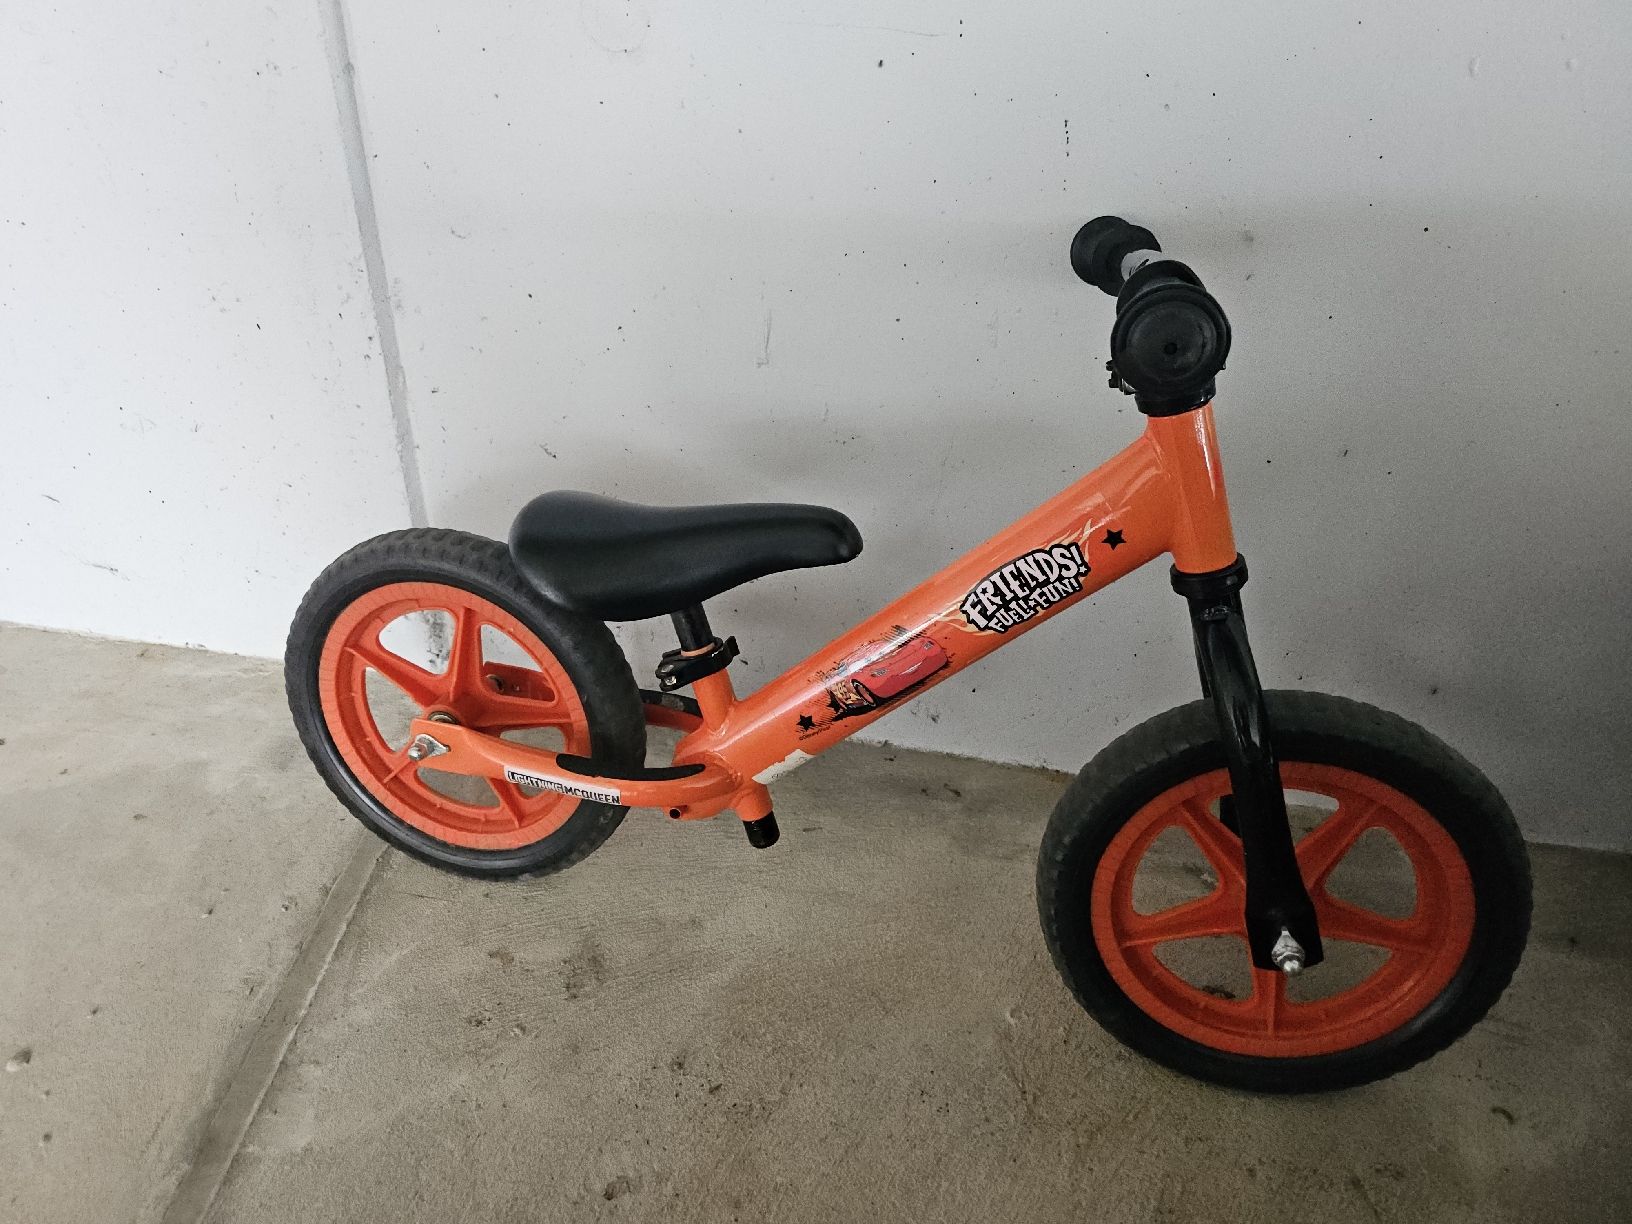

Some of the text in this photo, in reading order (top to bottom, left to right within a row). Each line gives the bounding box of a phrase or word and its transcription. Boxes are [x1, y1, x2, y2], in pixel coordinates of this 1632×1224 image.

[960, 545, 1087, 629] FRIENDS!
[1029, 577, 1080, 608] FUN!
[507, 770, 621, 805] LIGHTNING MCQUEEN
